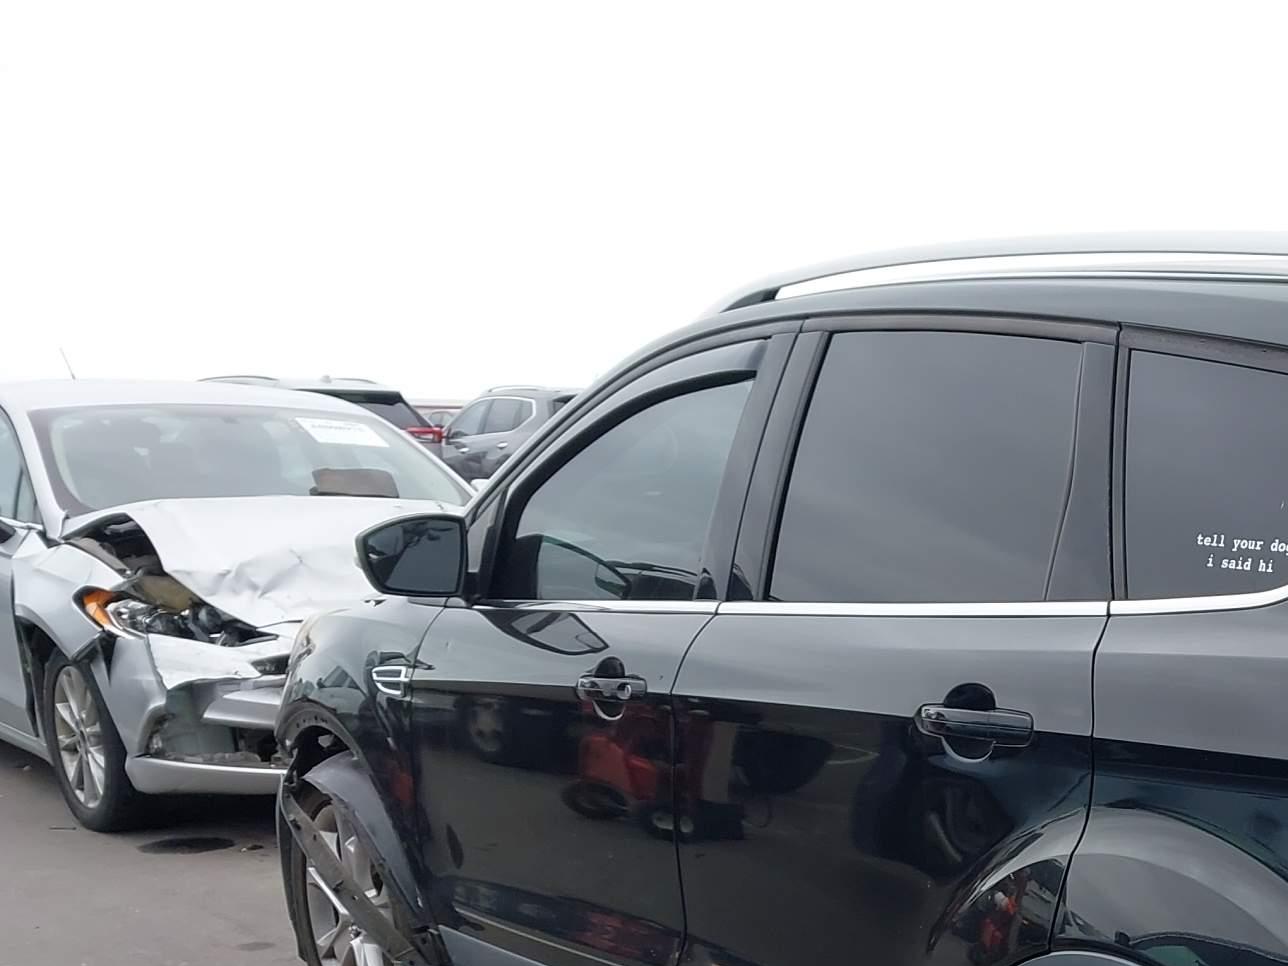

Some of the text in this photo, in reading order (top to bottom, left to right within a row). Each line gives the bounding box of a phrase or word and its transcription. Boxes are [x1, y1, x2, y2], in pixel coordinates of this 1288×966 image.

[1197, 534, 1225, 547] tell
[1232, 539, 1263, 551] your
[1207, 554, 1273, 573] i said hi
